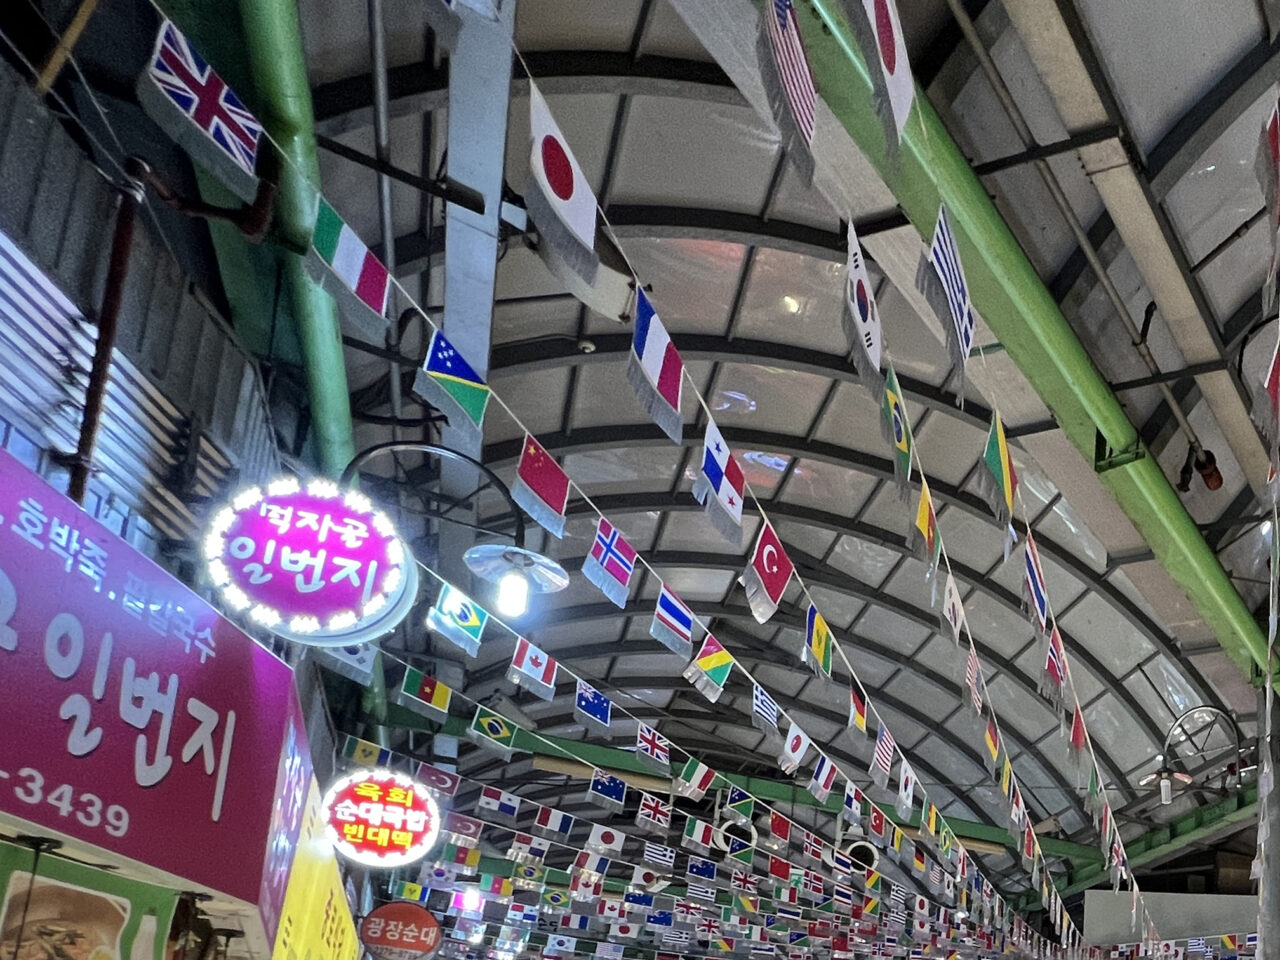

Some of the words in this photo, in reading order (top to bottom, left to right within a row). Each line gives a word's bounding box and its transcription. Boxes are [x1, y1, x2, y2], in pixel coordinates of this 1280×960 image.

[260, 503, 369, 548] 먹자골
[230, 537, 378, 604] 일번지
[343, 823, 413, 850] 빈대떡
[367, 917, 438, 946] 광장순대
